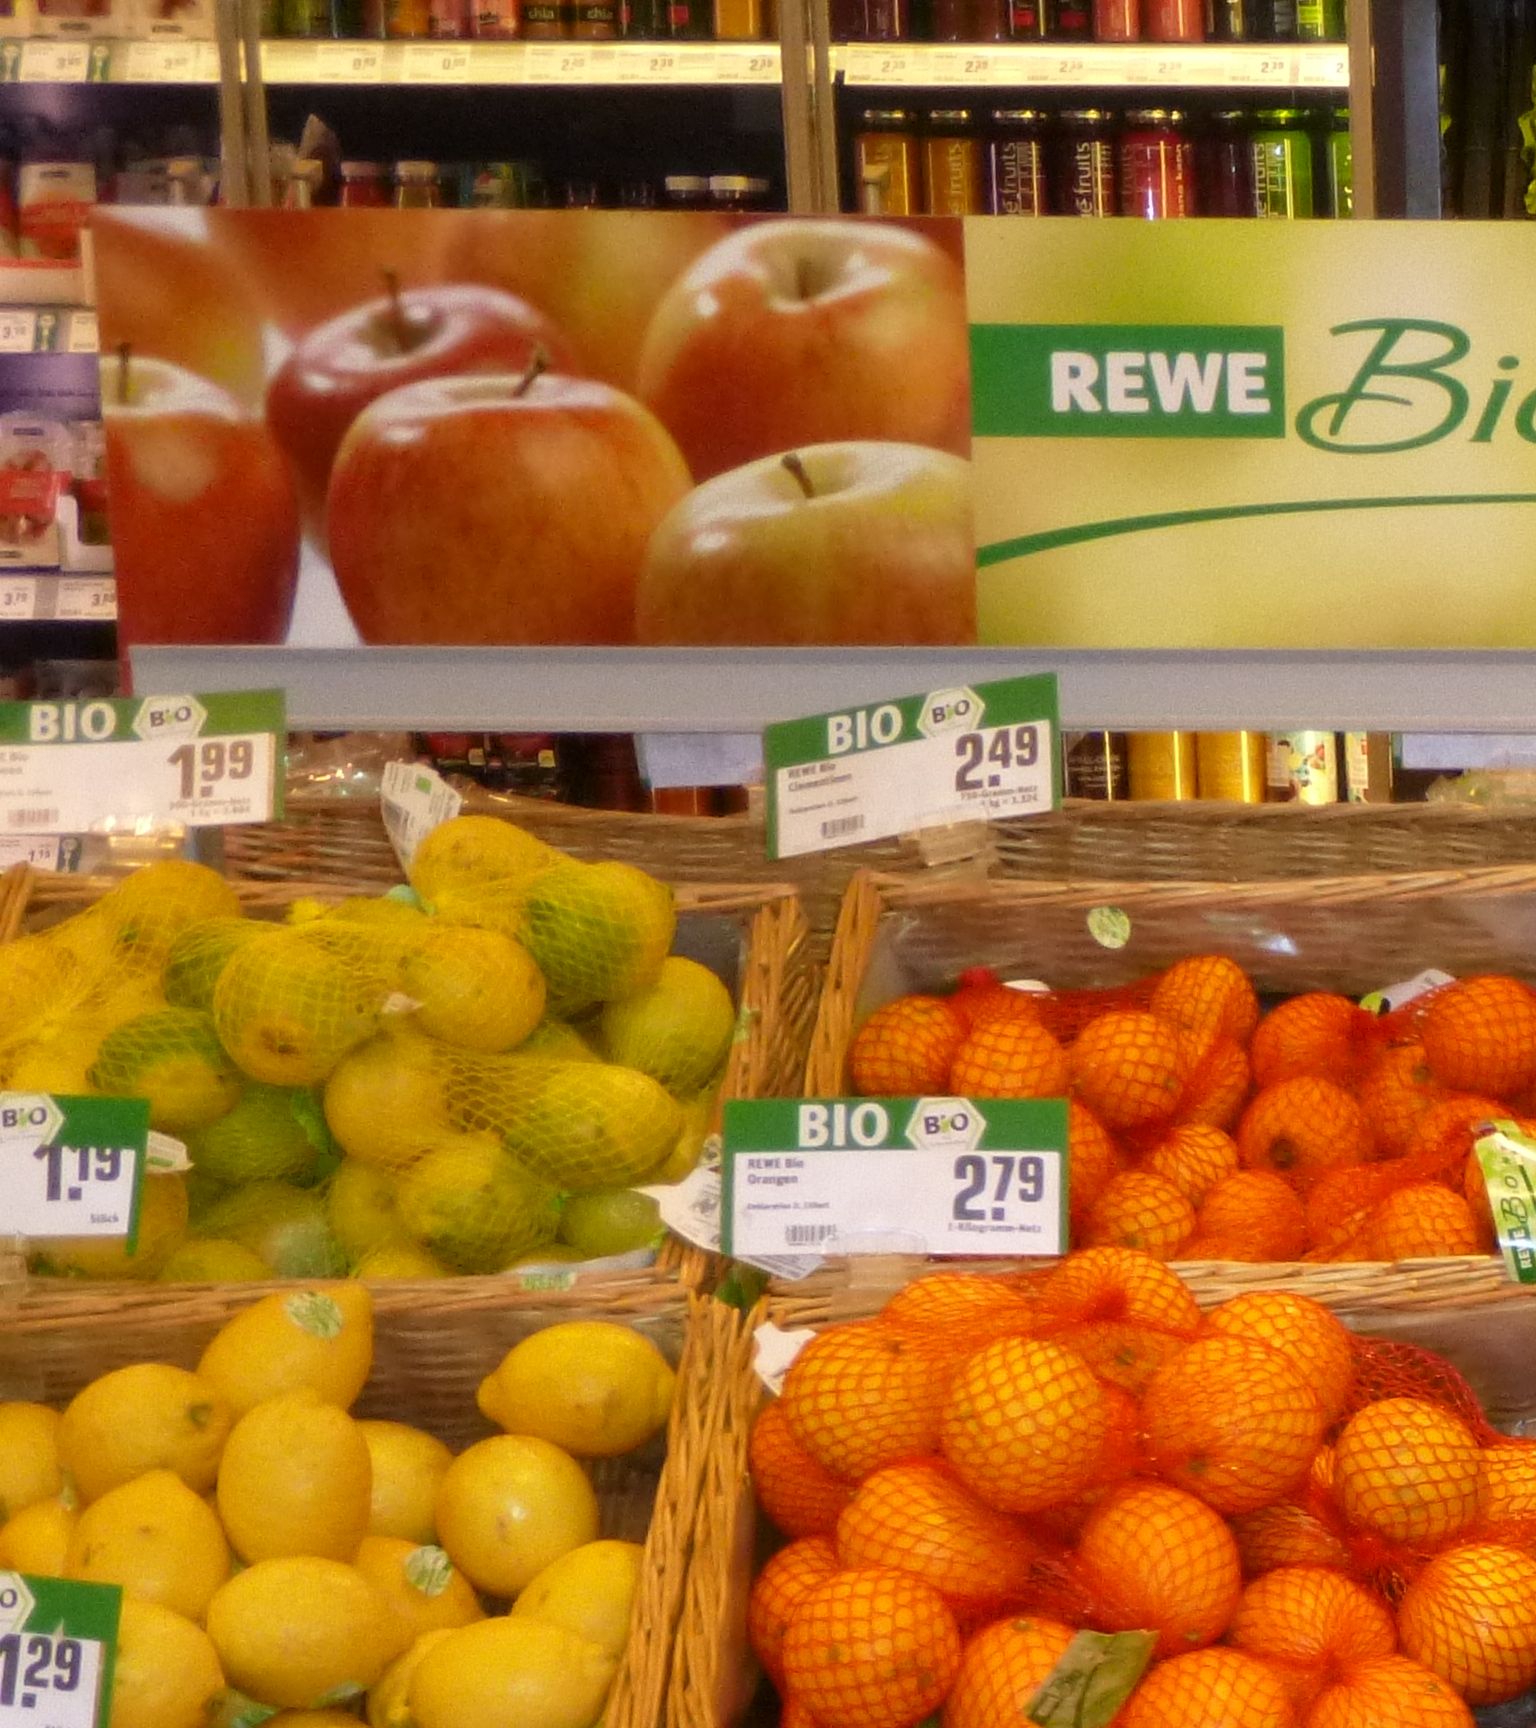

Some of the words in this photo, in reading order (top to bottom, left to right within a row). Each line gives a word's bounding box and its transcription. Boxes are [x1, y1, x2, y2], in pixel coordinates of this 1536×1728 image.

[1050, 351, 1270, 413] REWE
[29, 703, 116, 741] BIO
[828, 705, 903, 754] BIO
[167, 740, 254, 800] 1.99
[955, 725, 1038, 791] 2.49
[799, 1102, 889, 1147] BIO
[953, 1155, 1045, 1221] 2.79
[1512, 1227, 1532, 1269] REE
[0, 1633, 82, 1708] 1.29
